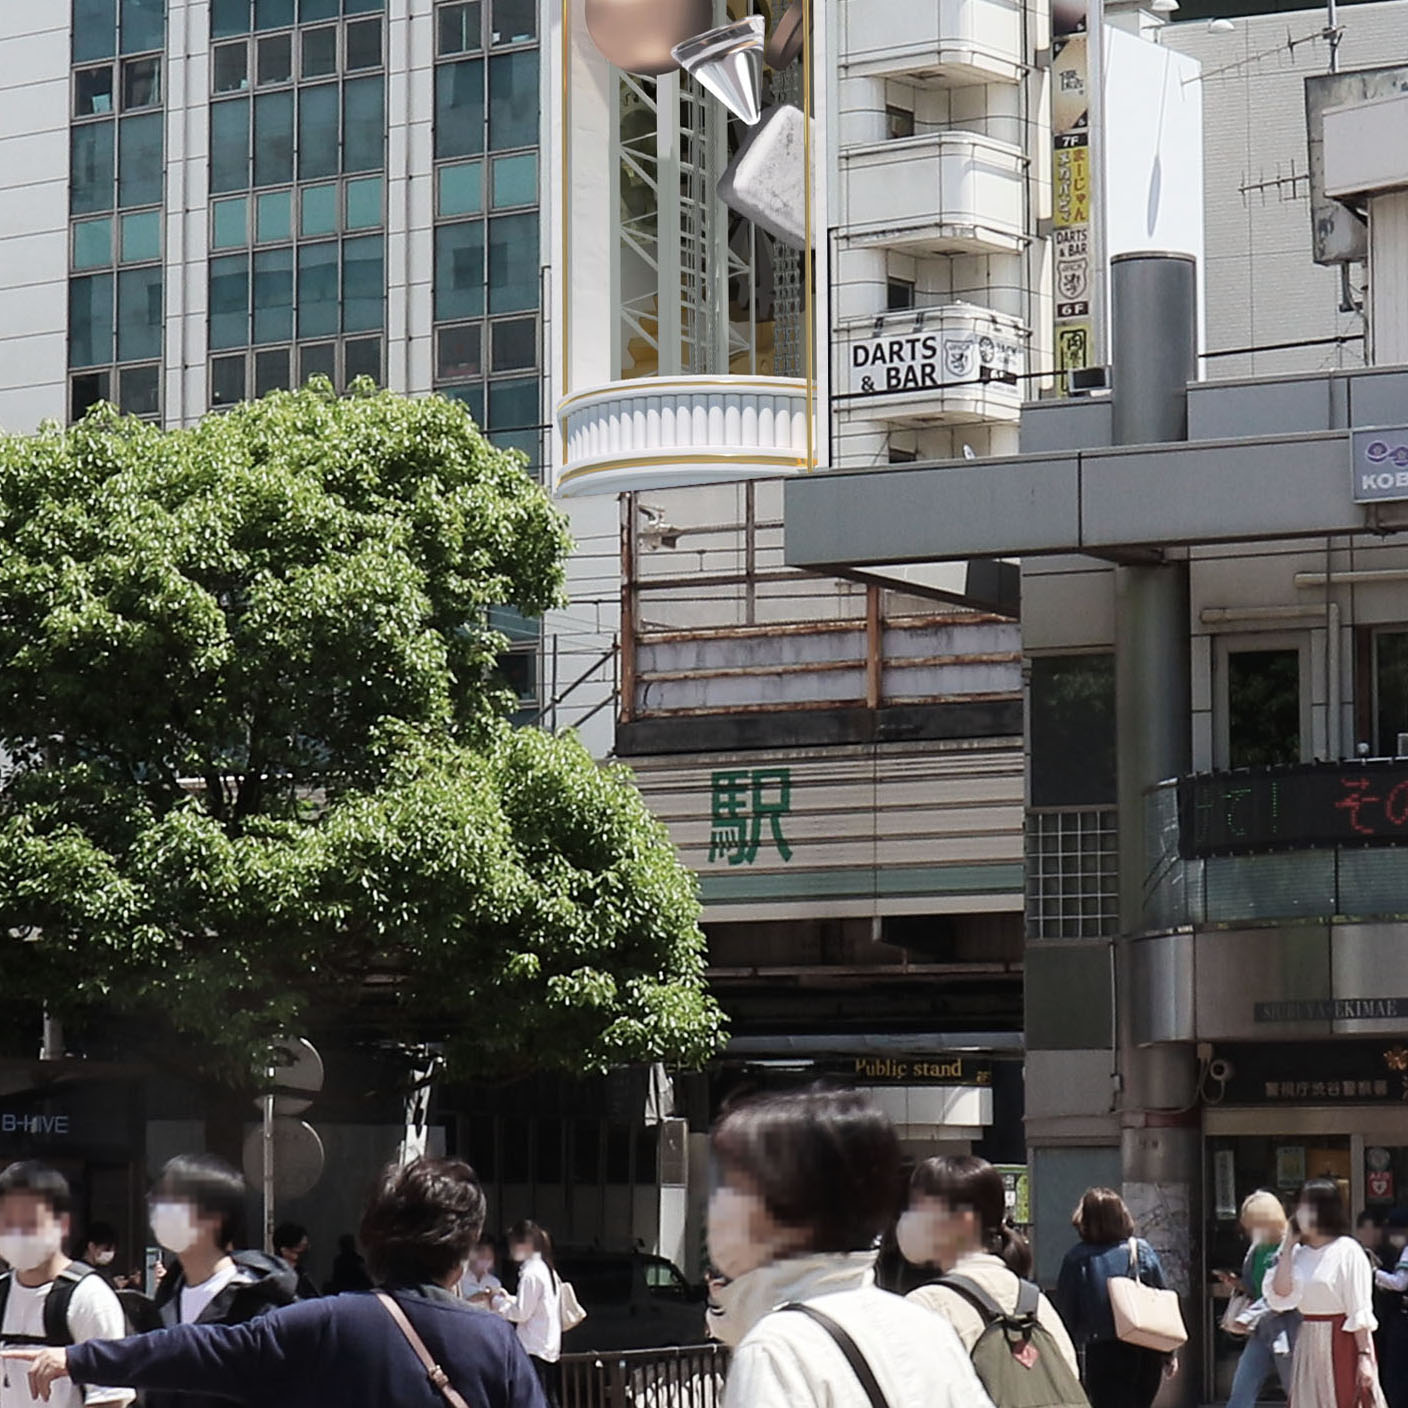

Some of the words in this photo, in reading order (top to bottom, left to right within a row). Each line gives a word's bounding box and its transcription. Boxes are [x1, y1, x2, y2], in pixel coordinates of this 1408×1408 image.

[1062, 135, 1080, 147] 7F
[1073, 149, 1086, 221] まーじゃん
[1056, 228, 1087, 244] DARTS
[1068, 243, 1088, 257] BAR
[853, 336, 938, 367] DARTS
[860, 375, 876, 393] &
[886, 363, 938, 390] BAR
[708, 768, 793, 865] 駅
[855, 1058, 907, 1077] Public
[912, 1058, 963, 1077] stand
[2, 1114, 69, 1133] B-HIVE
